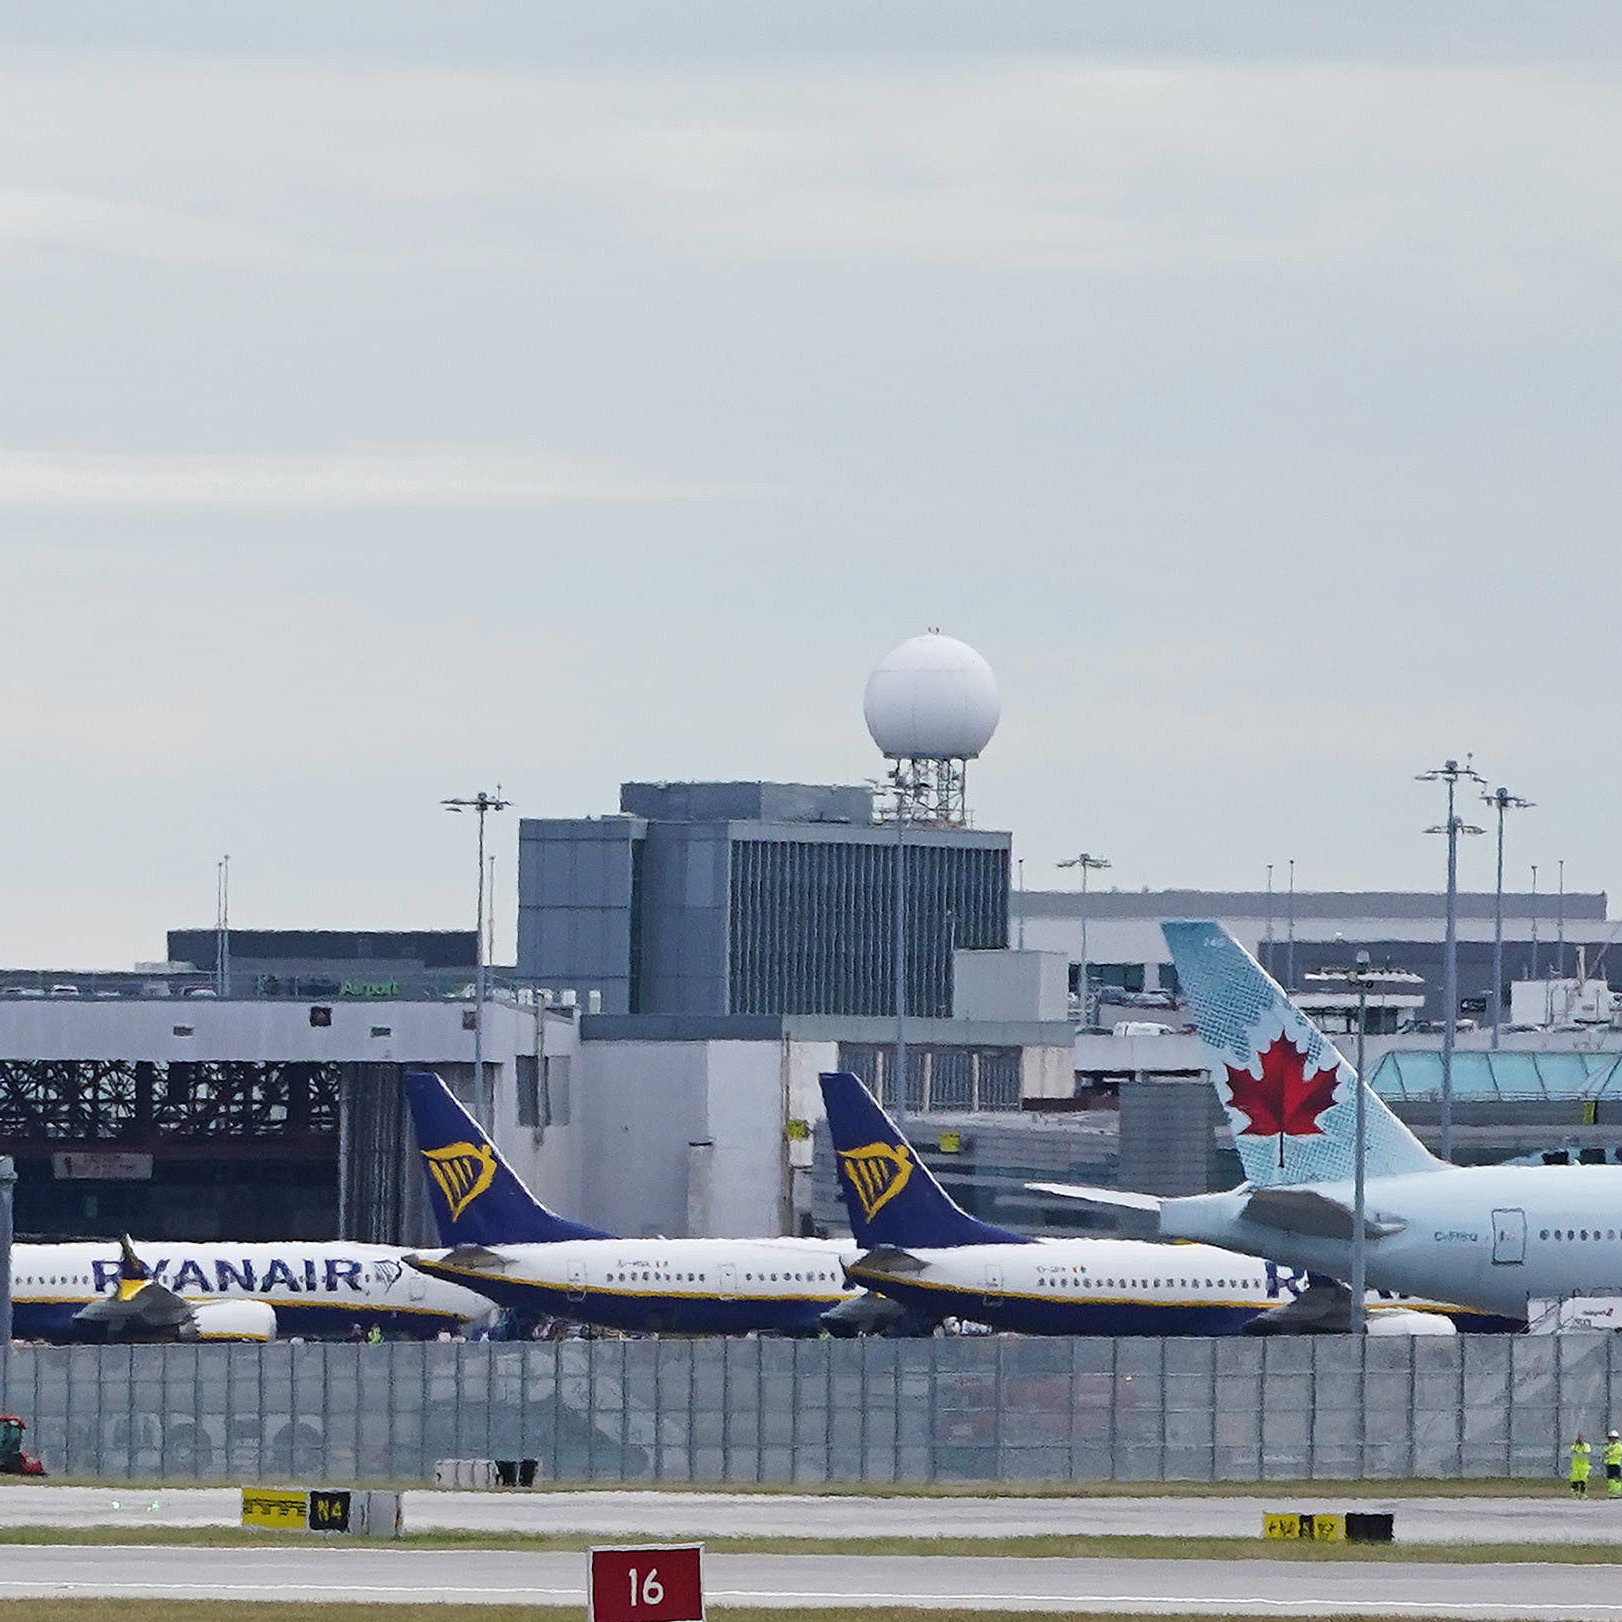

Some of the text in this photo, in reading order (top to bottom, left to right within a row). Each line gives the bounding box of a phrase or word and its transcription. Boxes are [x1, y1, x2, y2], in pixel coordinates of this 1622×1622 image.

[91, 1257, 363, 1293] RYANAIR
[316, 1498, 342, 1523] N4
[628, 1567, 664, 1607] 16
